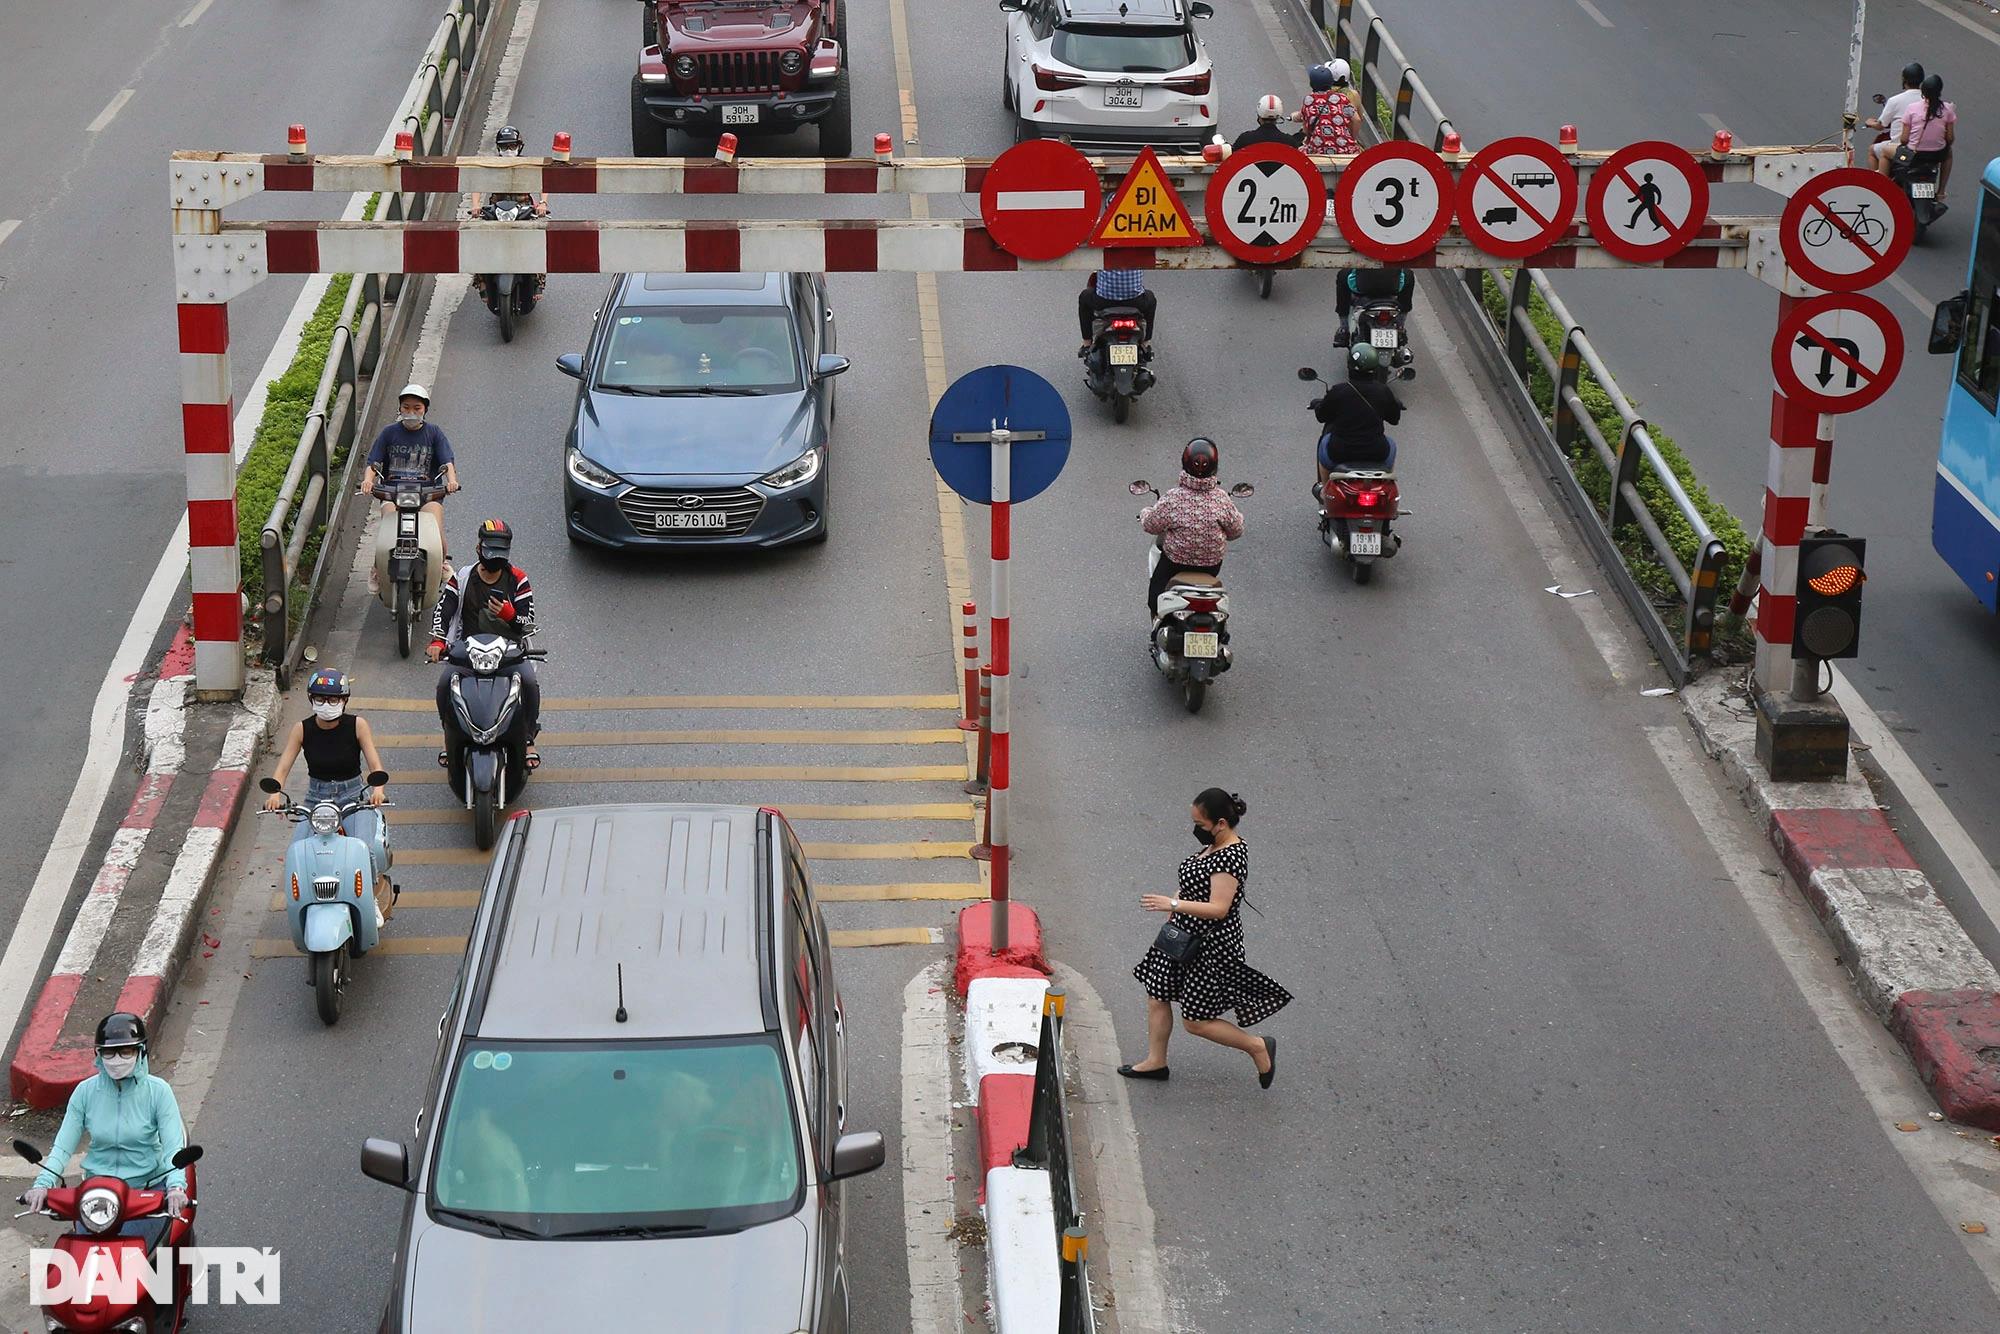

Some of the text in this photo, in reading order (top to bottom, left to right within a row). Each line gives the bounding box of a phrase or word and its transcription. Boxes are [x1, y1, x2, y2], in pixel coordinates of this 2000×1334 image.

[1116, 88, 1132, 96] 30H
[1109, 97, 1138, 105] 304.84
[732, 106, 748, 115] 30H
[726, 115, 755, 123] 591.32
[1135, 186, 1156, 206] ĐI
[1114, 209, 1176, 236] CHẬM
[657, 513, 724, 527] 30E-761.04
